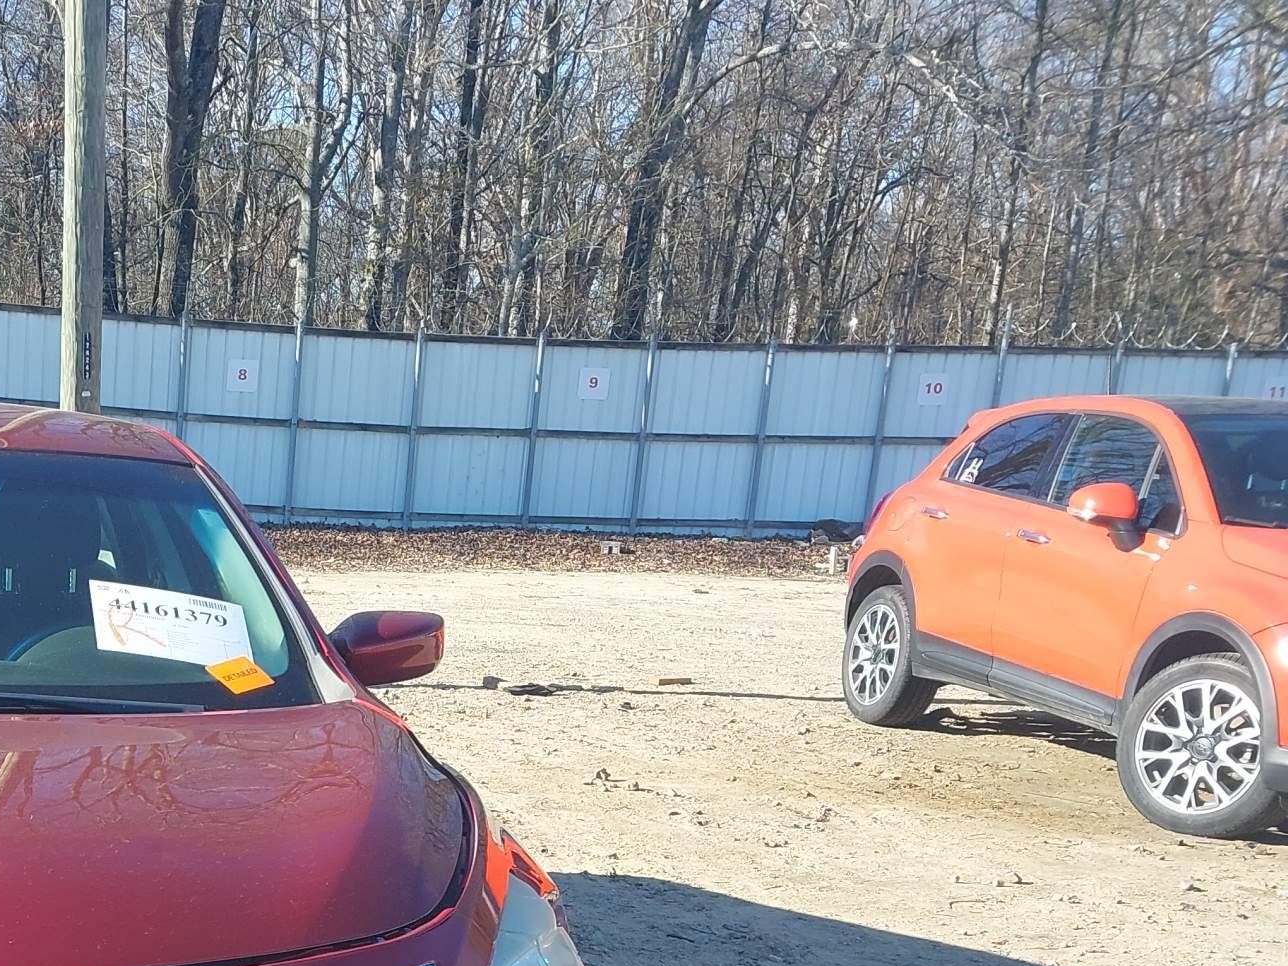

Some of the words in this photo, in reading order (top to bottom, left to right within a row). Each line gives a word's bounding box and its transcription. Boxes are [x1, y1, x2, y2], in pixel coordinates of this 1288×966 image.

[237, 368, 248, 381] 8
[589, 376, 599, 389] 9
[925, 382, 943, 394] 10
[109, 598, 227, 627] 44161379
[222, 667, 257, 682] DETAILED
